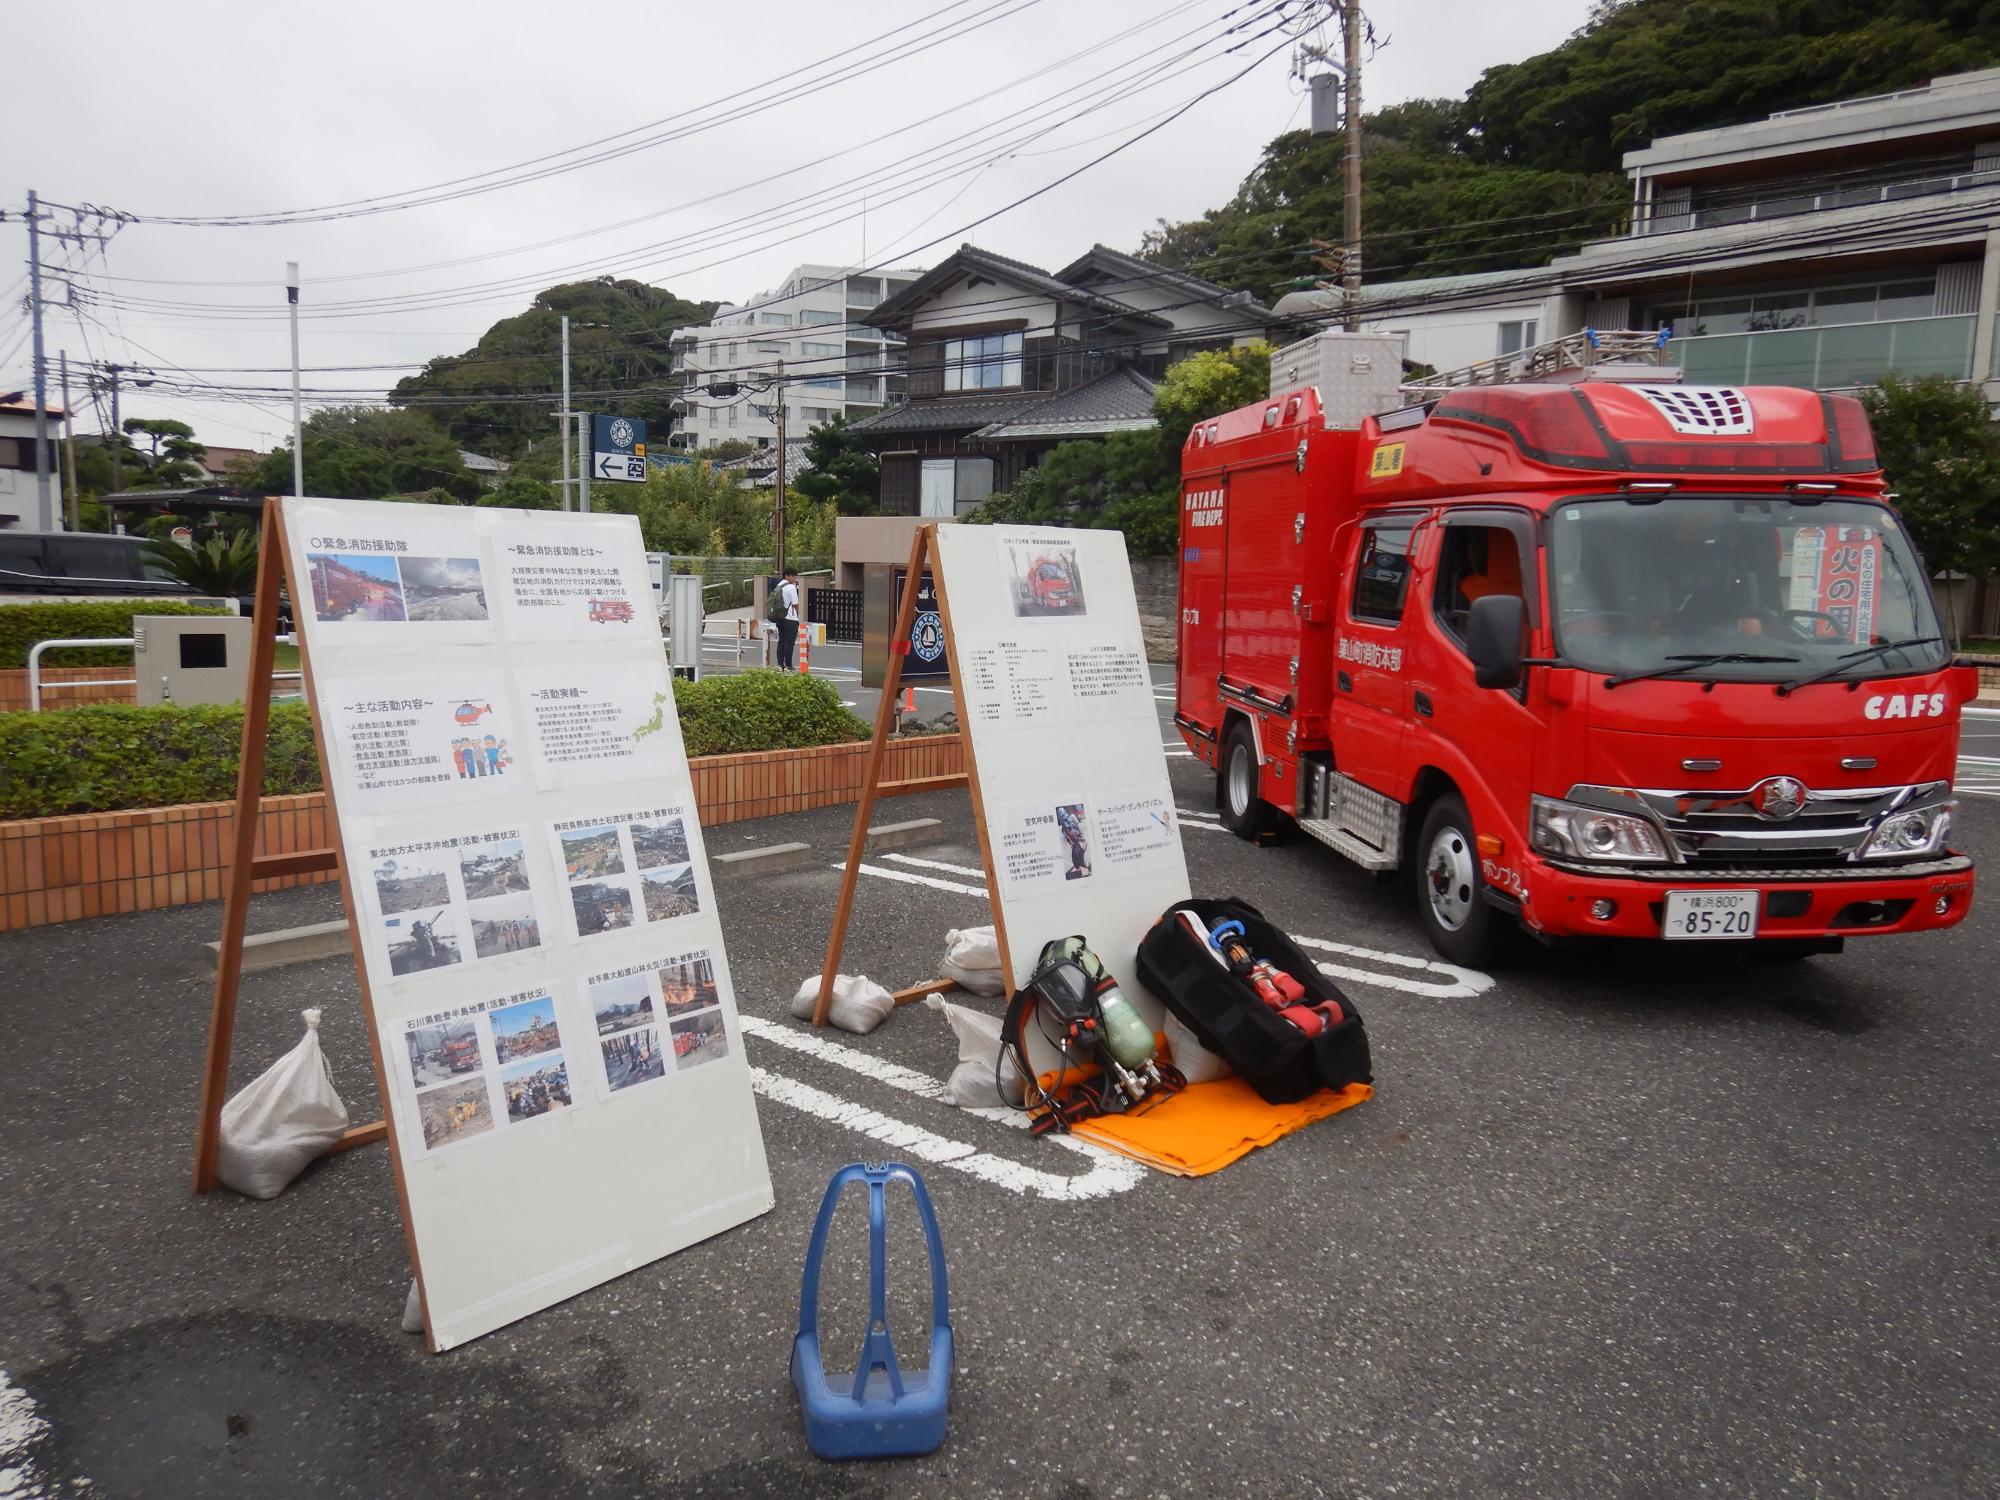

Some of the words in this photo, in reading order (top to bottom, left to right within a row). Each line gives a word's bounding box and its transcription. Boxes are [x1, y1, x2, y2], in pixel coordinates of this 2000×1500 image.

[628, 457, 644, 478] 空
[1185, 489, 1224, 511] HAYAMA
[1864, 693, 1945, 720] CAFS
[1672, 919, 1683, 927] つ
[1685, 910, 1751, 934] 85-20
